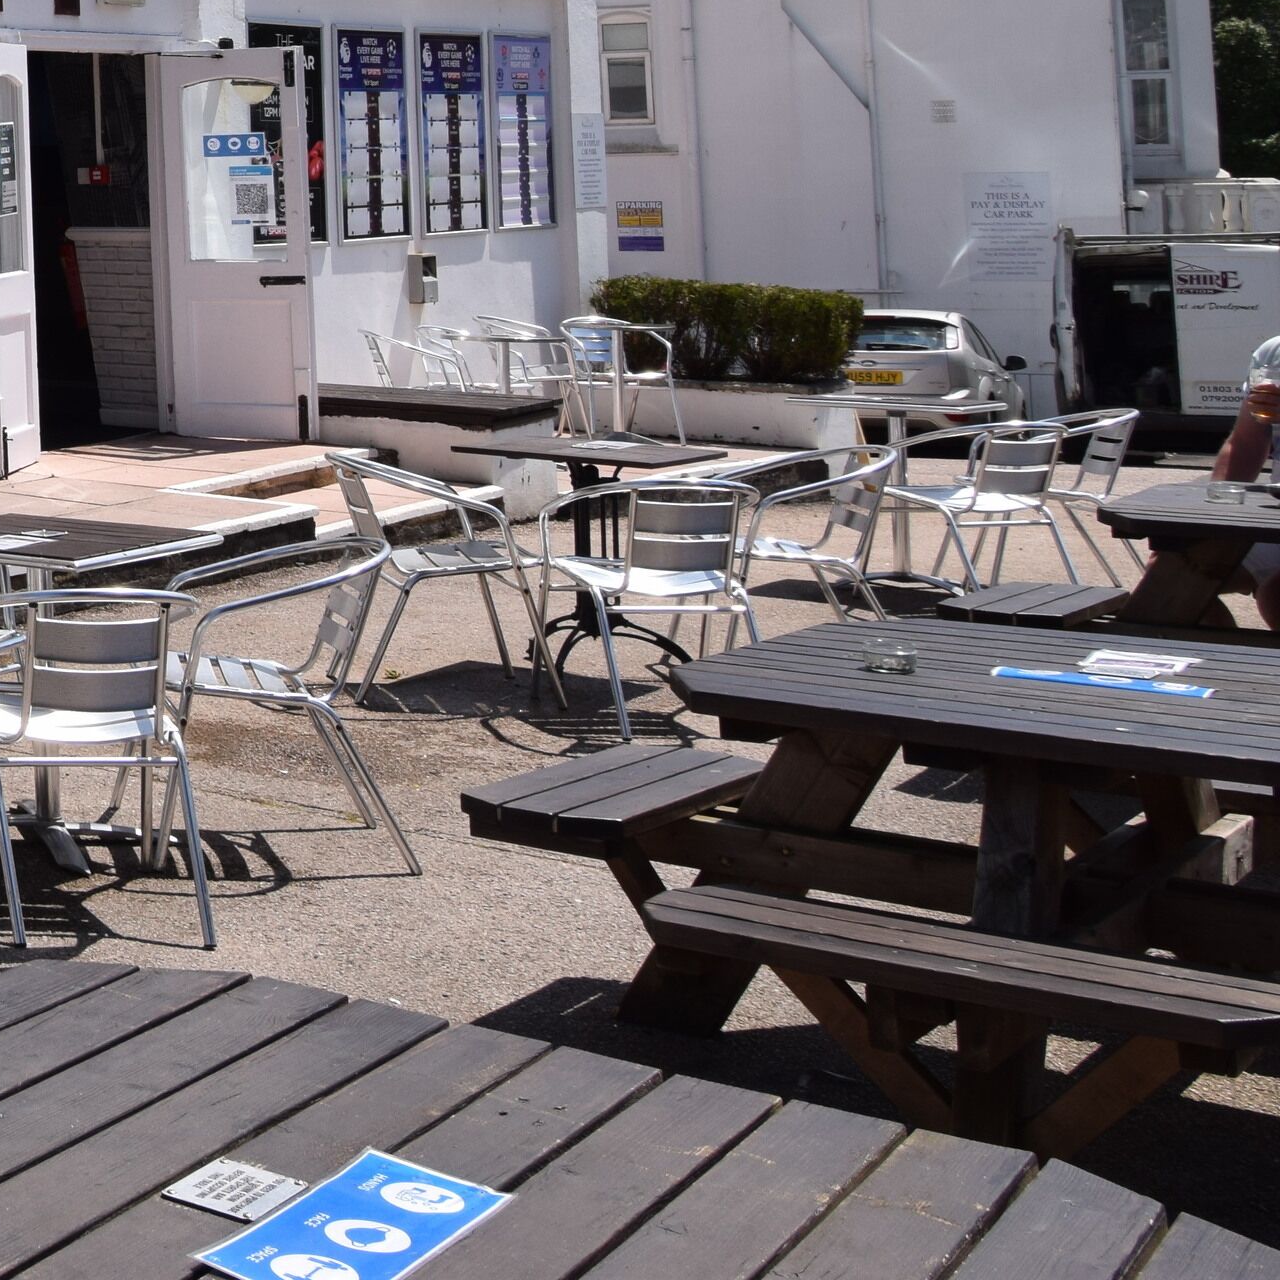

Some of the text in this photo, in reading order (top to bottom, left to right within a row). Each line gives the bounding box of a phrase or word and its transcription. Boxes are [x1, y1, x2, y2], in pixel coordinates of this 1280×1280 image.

[275, 33, 294, 48] THE
[984, 192, 1030, 201] THIS IS A
[625, 201, 662, 209] PARKING
[970, 201, 1046, 209] PAY & DISPLAY
[983, 210, 1034, 218] CAR PARK
[1177, 270, 1243, 289] SHIRE
[1207, 302, 1259, 312] Development
[876, 370, 898, 381] HJY
[357, 1173, 388, 1192] HANDS
[304, 1212, 331, 1228] FACE
[246, 1245, 279, 1263] SPACE
